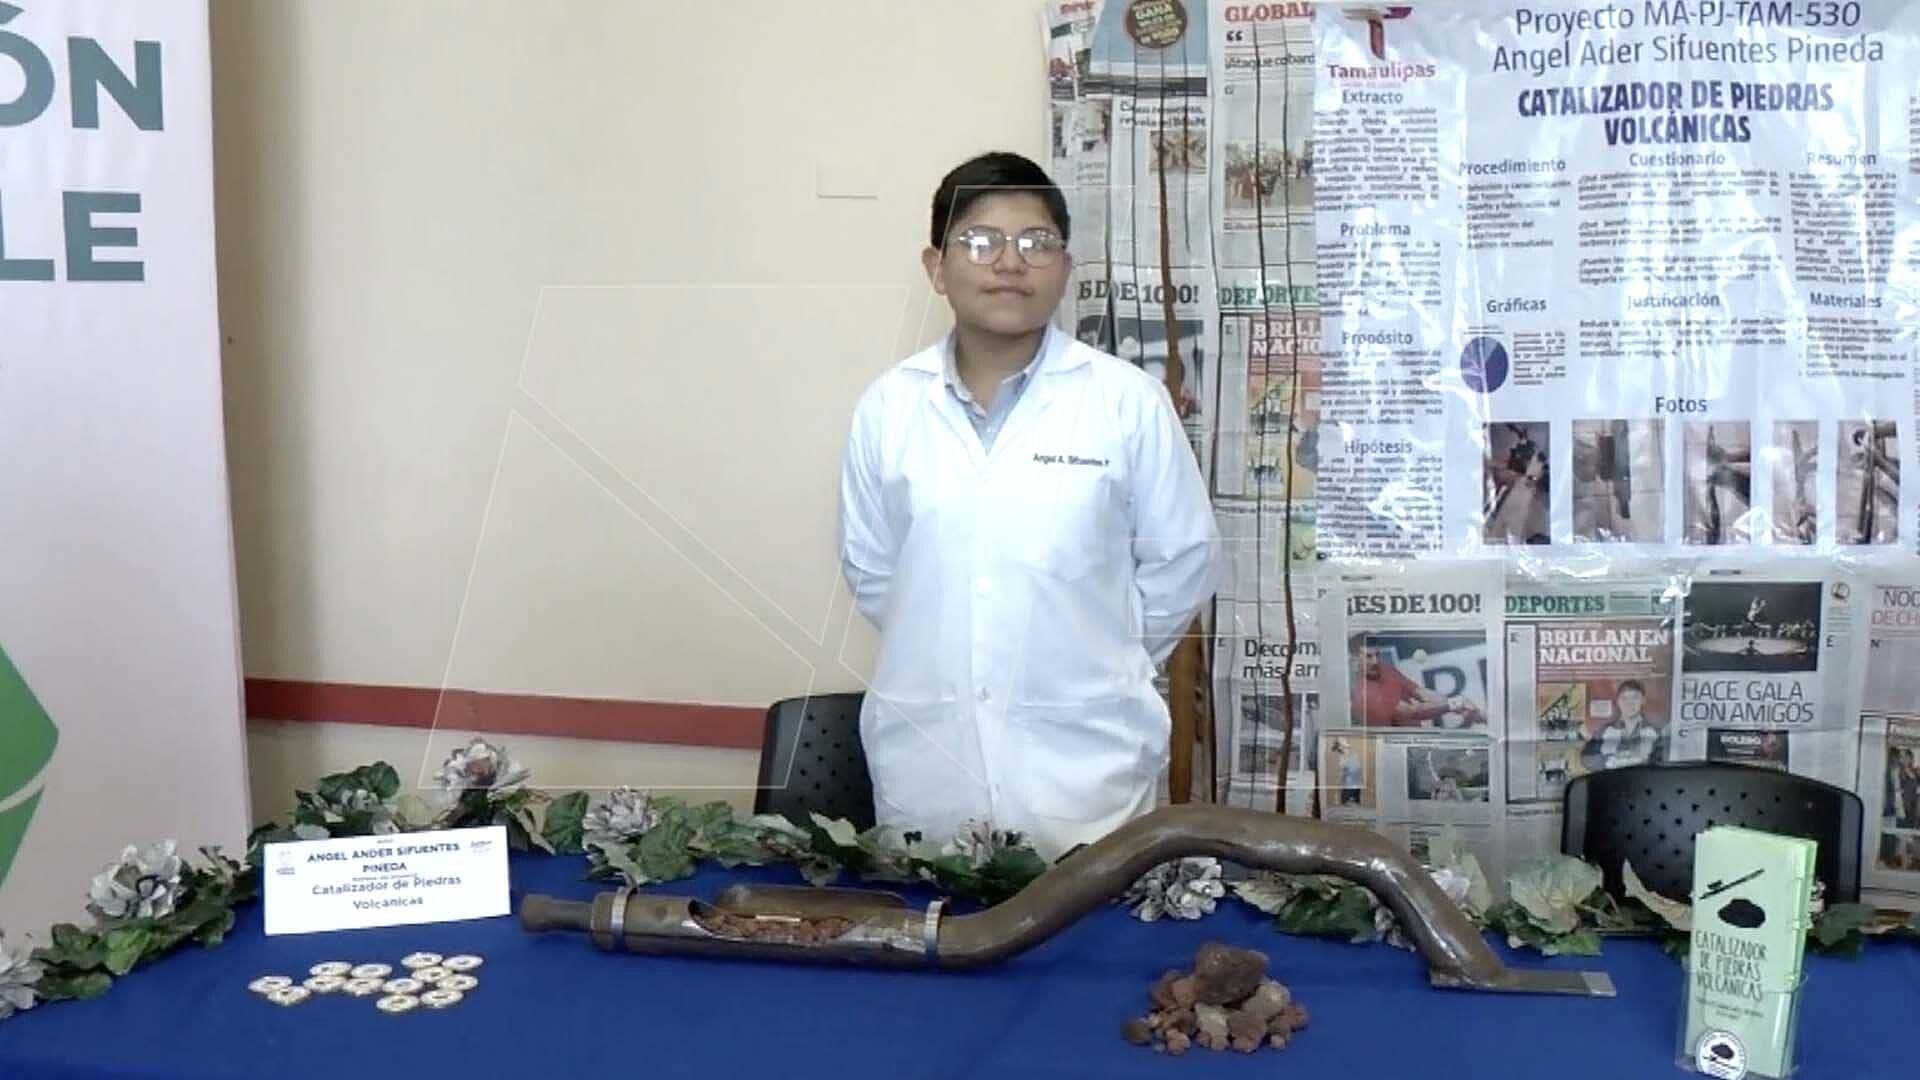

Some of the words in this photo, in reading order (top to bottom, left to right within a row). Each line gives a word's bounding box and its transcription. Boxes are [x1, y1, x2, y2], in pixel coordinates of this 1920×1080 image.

[1515, 6, 1634, 38] Proyecto
[1643, 1, 1861, 28] MA-PJ-TAM-530
[1493, 41, 1570, 77] Angel
[1580, 38, 1643, 68] Ader
[1652, 32, 1777, 63] Sifuentes
[1788, 34, 1884, 63] Pineda
[1328, 63, 1436, 83] Tamaulipas
[1342, 89, 1404, 105] Extracto
[1518, 81, 1683, 117] CATALIZADOR
[1691, 80, 1723, 110] DE
[1730, 81, 1834, 111] PIEDRAS
[1604, 111, 1752, 146] VOLCÁNICAS
[1458, 159, 1567, 175] Procedimiento
[1629, 151, 1726, 167] Cuestionario
[1807, 151, 1877, 165] Resumen
[1340, 221, 1412, 236] Problema
[1486, 297, 1547, 313] Gráficas
[1628, 292, 1721, 310] Justificación
[1810, 291, 1883, 309] Materiales
[1341, 329, 1414, 346] Propósito
[1655, 396, 1708, 413] Fotos
[1344, 439, 1413, 455] Hipótesis
[1391, 595, 1428, 614] DE
[1430, 594, 1481, 613] 100!
[1505, 594, 1606, 614] DEPORTES
[1539, 628, 1637, 646] BRILLAN
[1639, 629, 1669, 646] EN
[1539, 646, 1653, 664] NACIONAL
[1681, 680, 1739, 701] HACE
[1746, 680, 1804, 701] GALA
[1680, 702, 1727, 723] CON
[1729, 702, 1815, 723] AMIGOS
[307, 850, 347, 864] ANGEL
[352, 846, 393, 859] ANDER
[397, 842, 461, 856] SIFUENTES
[362, 862, 407, 874] PINEDA
[312, 880, 389, 896] Catalizador
[393, 876, 409, 890] de
[413, 874, 462, 889] Piedras
[1695, 930, 1767, 962] CATALIZADOR
[1699, 949, 1711, 970] DE
[1716, 954, 1761, 983] PIEDRAS
